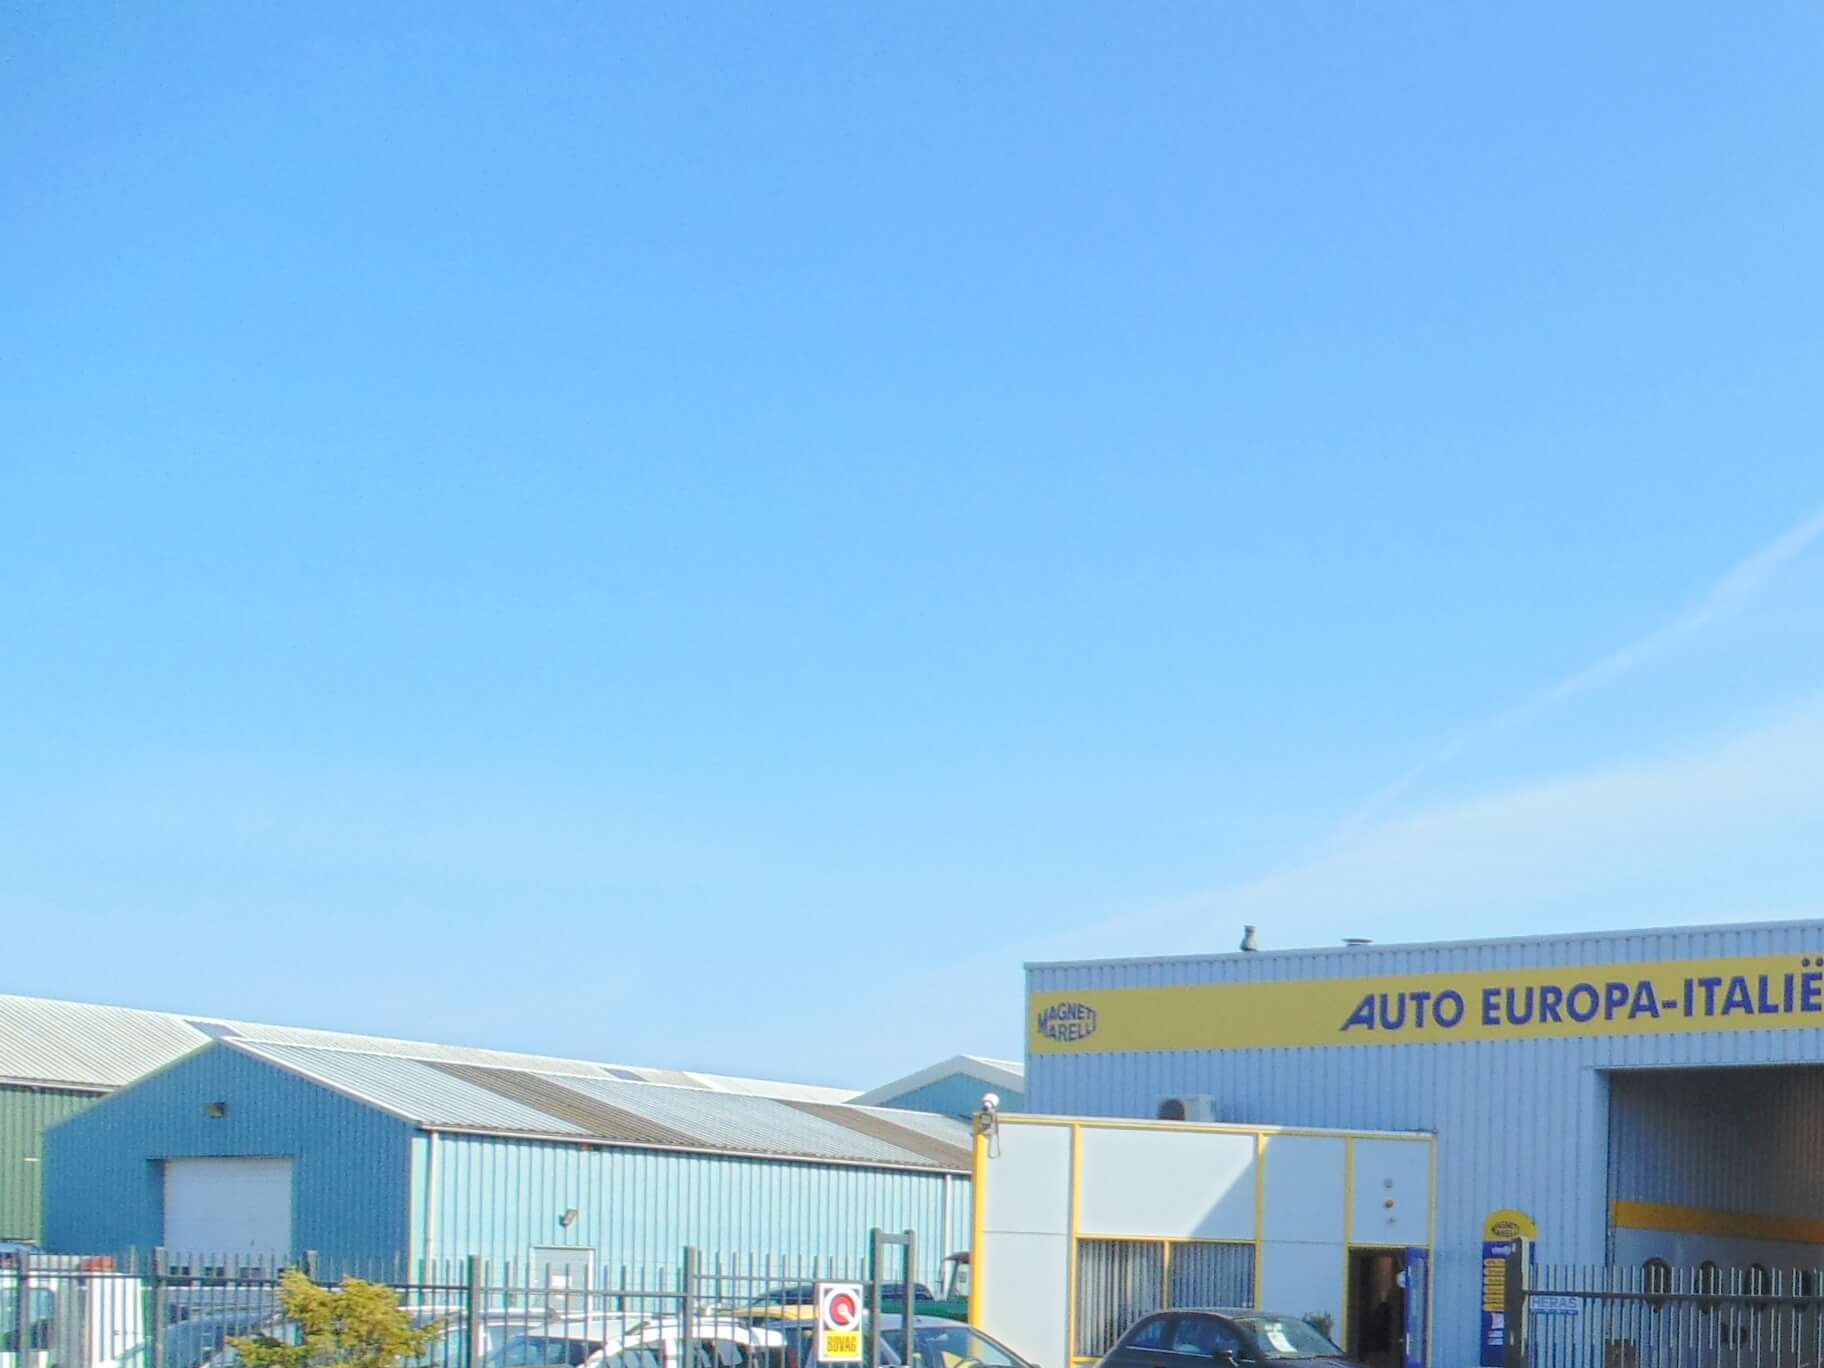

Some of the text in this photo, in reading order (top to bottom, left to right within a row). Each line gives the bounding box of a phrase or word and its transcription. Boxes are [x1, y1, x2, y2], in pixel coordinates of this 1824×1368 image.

[1339, 958, 1824, 1031] AUTO EUROPA-ITALIË
[1531, 1297, 1578, 1309] HERAS
